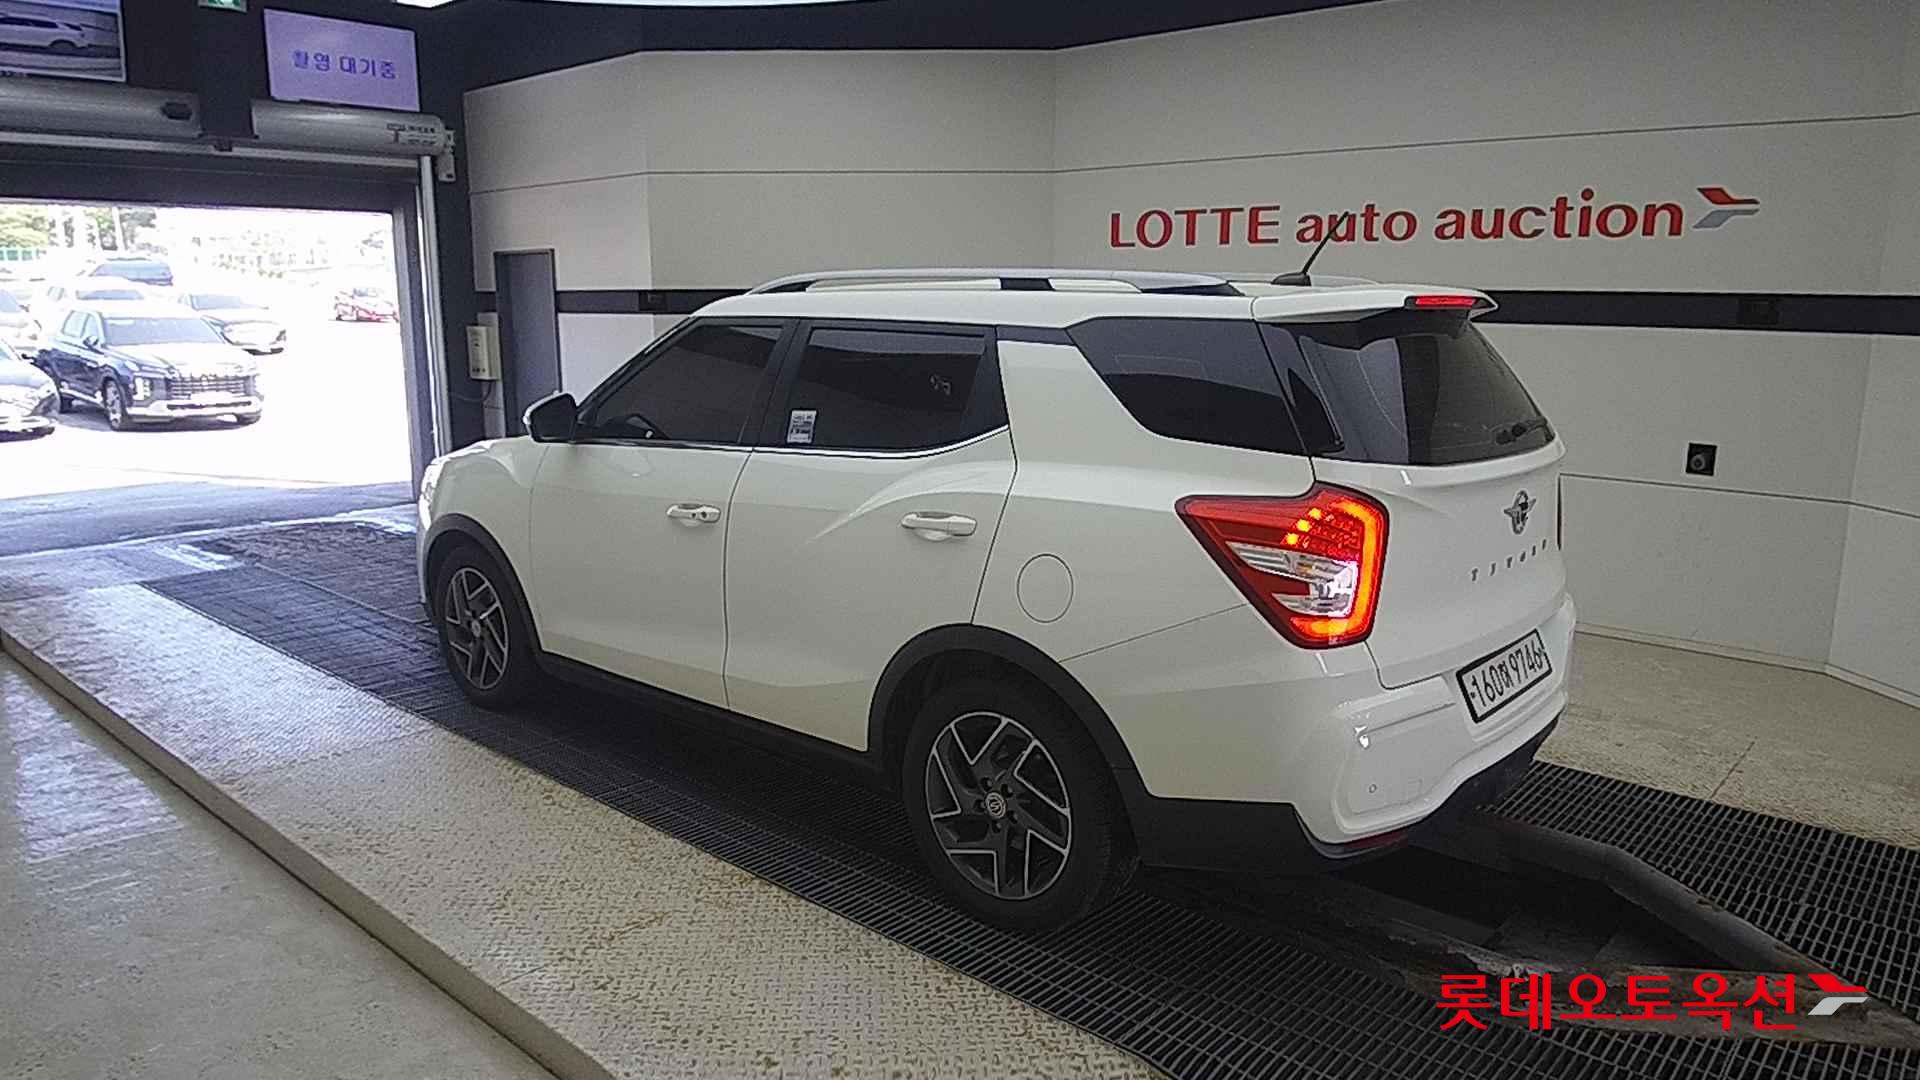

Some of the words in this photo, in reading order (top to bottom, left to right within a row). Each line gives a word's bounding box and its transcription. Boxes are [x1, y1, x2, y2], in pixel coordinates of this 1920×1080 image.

[339, 55, 397, 80] 대기중
[1110, 205, 1281, 249] LOTTE
[1295, 203, 1418, 244] auto
[1433, 187, 1684, 241] auction
